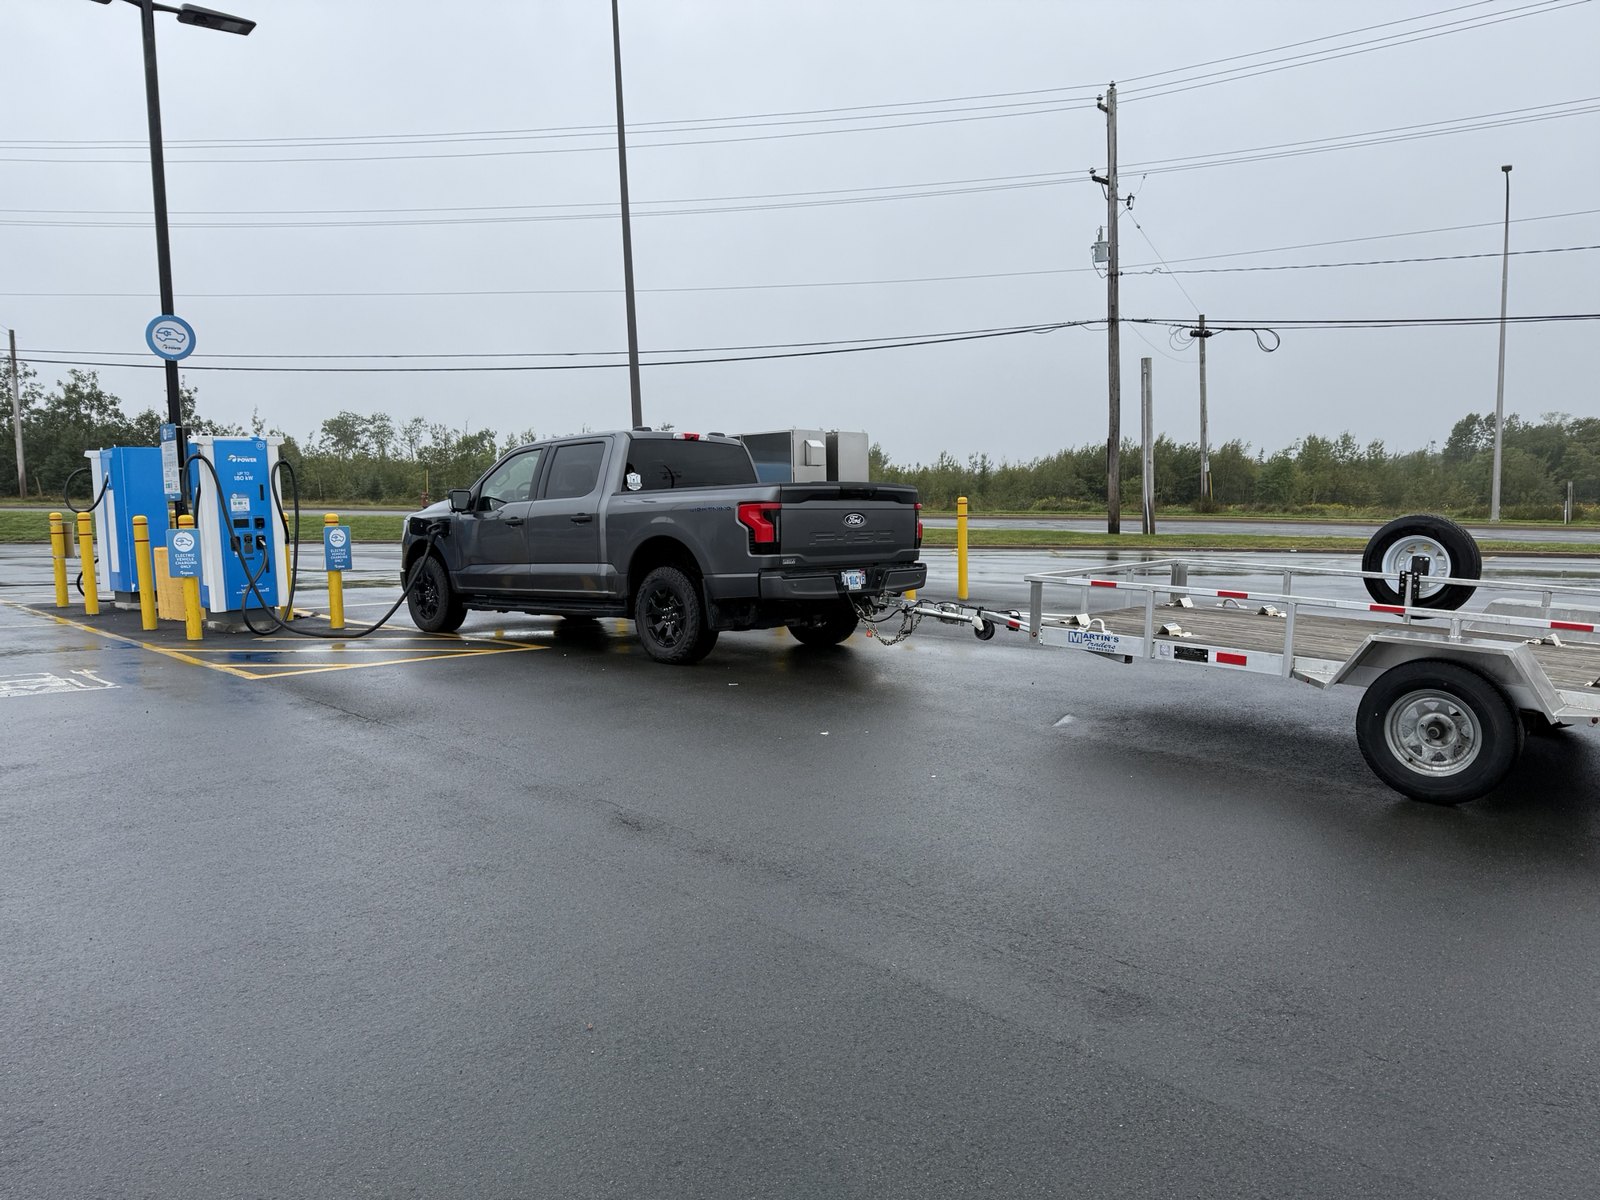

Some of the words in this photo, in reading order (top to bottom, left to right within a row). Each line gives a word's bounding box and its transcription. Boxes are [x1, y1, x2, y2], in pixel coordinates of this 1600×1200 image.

[848, 515, 862, 524] Ford
[809, 529, 896, 546] F-150
[1068, 631, 1120, 644] MARTIN'S
[1084, 639, 1116, 650] Trailers
